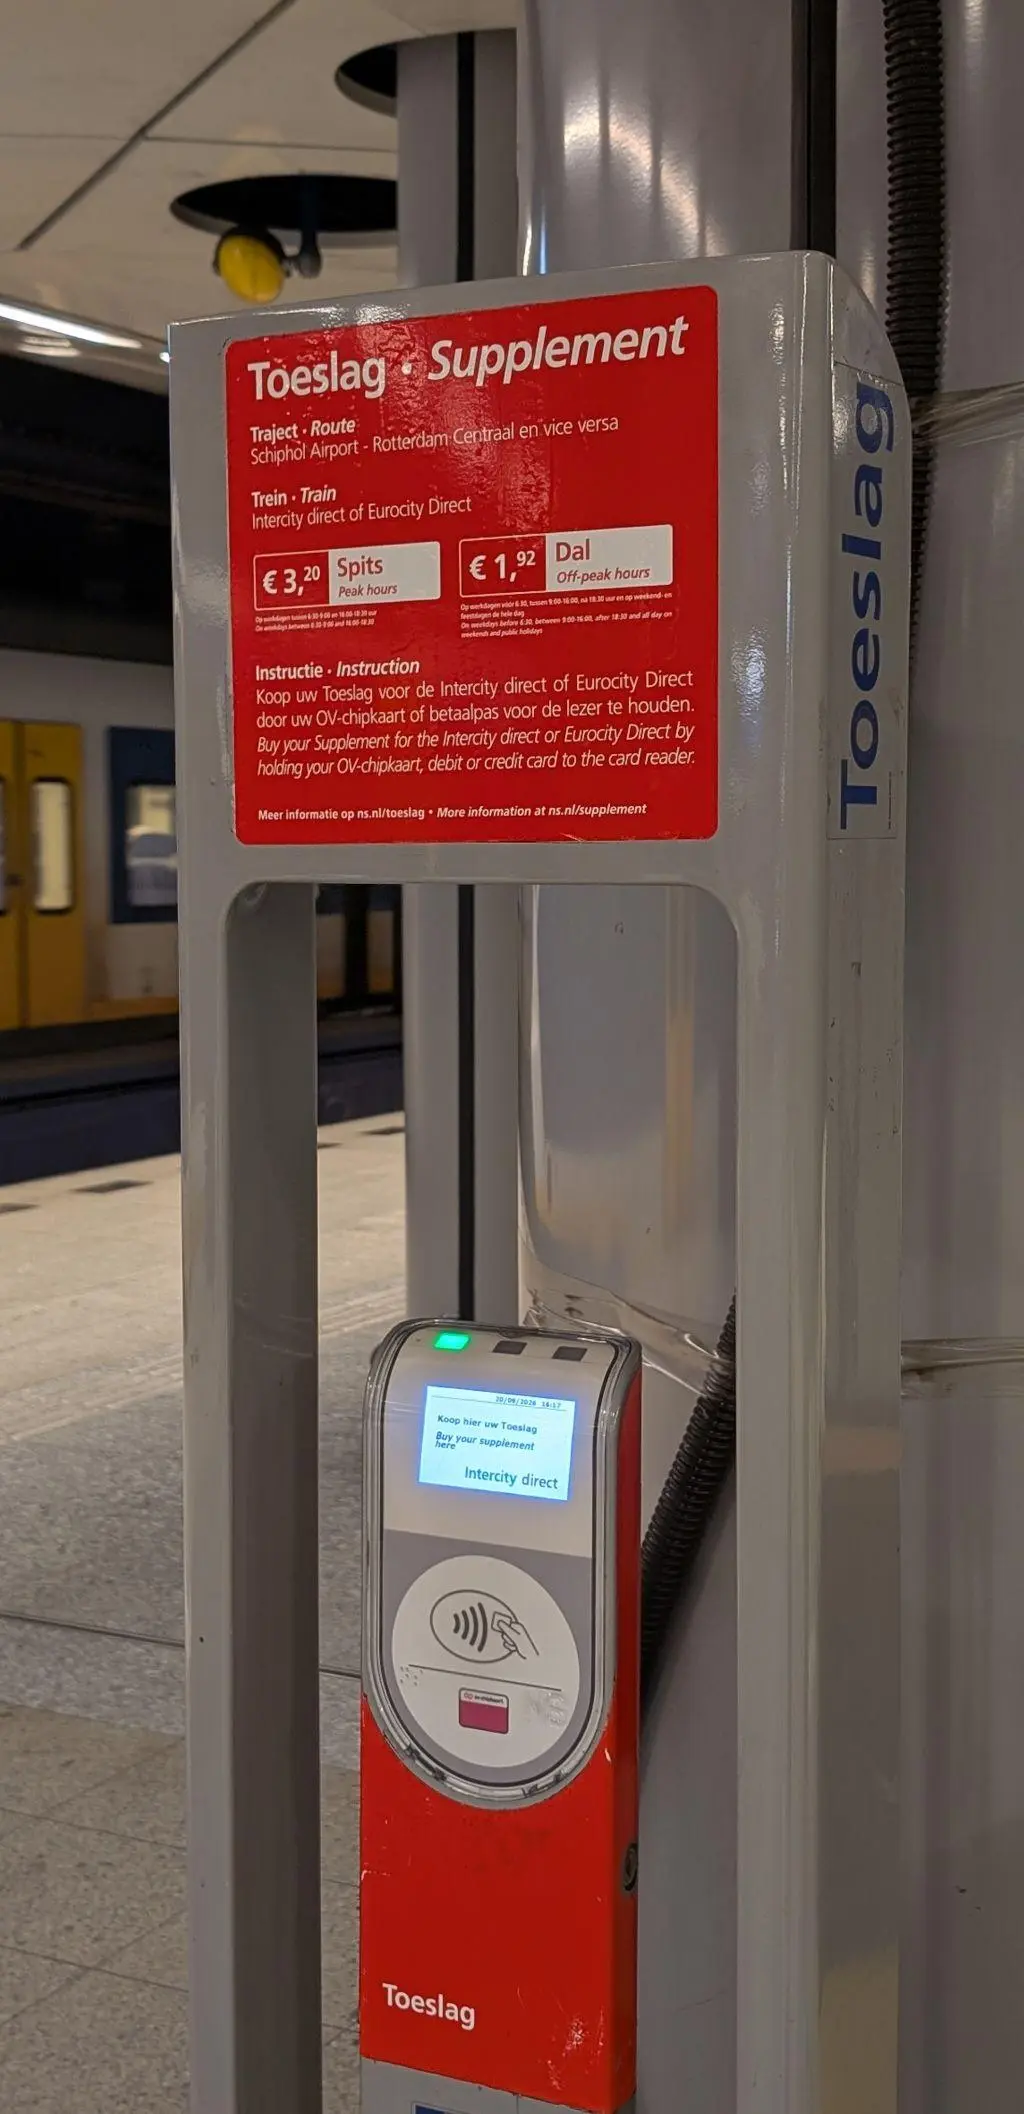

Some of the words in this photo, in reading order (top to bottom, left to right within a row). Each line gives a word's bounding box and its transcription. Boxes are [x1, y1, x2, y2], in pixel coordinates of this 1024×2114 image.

[248, 350, 387, 401] Toeslag
[428, 316, 688, 386] Supplement
[250, 424, 298, 444] Traject
[311, 418, 355, 436] Route
[251, 443, 305, 466] Schiphol
[310, 440, 358, 461] Airport
[374, 430, 451, 452] Rotterdam
[453, 422, 514, 444] Centraal
[520, 425, 538, 438] en
[544, 418, 572, 436] vice
[578, 418, 618, 432] versa
[252, 489, 287, 507] Trein
[300, 485, 336, 503] Train
[253, 510, 303, 530] Intercity
[308, 508, 345, 524] direct
[350, 503, 363, 521] of
[368, 500, 424, 520] Eurocity
[429, 496, 471, 514] Direct
[556, 538, 590, 562] Dal
[337, 555, 383, 581] Spits
[470, 555, 486, 580] €
[556, 568, 612, 586] Off-peak
[614, 566, 650, 581] hours
[263, 570, 277, 594] €
[338, 583, 363, 598] Peak
[364, 582, 398, 597] hours
[839, 382, 892, 829] Toeslag
[256, 664, 323, 680] Instructie
[337, 658, 419, 676] Instruction
[257, 689, 290, 707] Koop
[297, 691, 318, 702] uw
[322, 684, 372, 704] Toeslag
[378, 686, 410, 699] voor
[416, 680, 434, 697] de
[441, 678, 498, 699] Intercity
[504, 677, 546, 694] direct
[554, 674, 569, 692] of
[577, 672, 638, 693] Eurocity
[646, 670, 693, 688] Direct
[257, 712, 287, 728] door
[292, 715, 312, 726] uw
[316, 708, 405, 728] OV-chipkaart
[410, 705, 425, 722] of
[430, 703, 498, 724] betaalpas
[504, 706, 537, 718] voor
[542, 700, 561, 717] de
[567, 700, 602, 716] lezer
[607, 700, 622, 714] te
[629, 695, 694, 713] houden.
[258, 737, 280, 756] Buy
[282, 739, 311, 755] your
[314, 733, 390, 754] Supplement
[394, 731, 413, 748] for
[418, 730, 439, 747] the
[443, 728, 497, 749] Intercity
[501, 727, 540, 744] direct
[544, 730, 560, 742] or
[564, 724, 622, 745] Eurocity
[626, 723, 671, 740] Direct
[675, 721, 695, 742] by
[258, 759, 303, 779] holding
[305, 762, 334, 778] your
[337, 756, 423, 776] OV-chipkaart,
[428, 754, 463, 771] debit
[466, 758, 482, 770] or
[485, 752, 524, 769] credit
[527, 750, 558, 768] card
[562, 753, 576, 767] to
[582, 750, 604, 766] the
[609, 748, 641, 766] card
[645, 747, 694, 765] reader.
[259, 810, 283, 820] Meer
[286, 809, 338, 819] informatie
[341, 811, 354, 820] op
[358, 807, 424, 820] ns.nl/toeslag
[437, 808, 465, 817] More
[468, 806, 531, 816] information
[534, 806, 546, 816] at
[548, 804, 647, 817] ns.nl/supplement
[438, 1415, 460, 1425] Koop
[463, 1418, 481, 1427] hier
[435, 1440, 456, 1450] here
[436, 1431, 453, 1442] Buy
[464, 1466, 517, 1487] Intercity
[522, 1472, 558, 1489] direct
[382, 1983, 475, 2031] Toeslag
